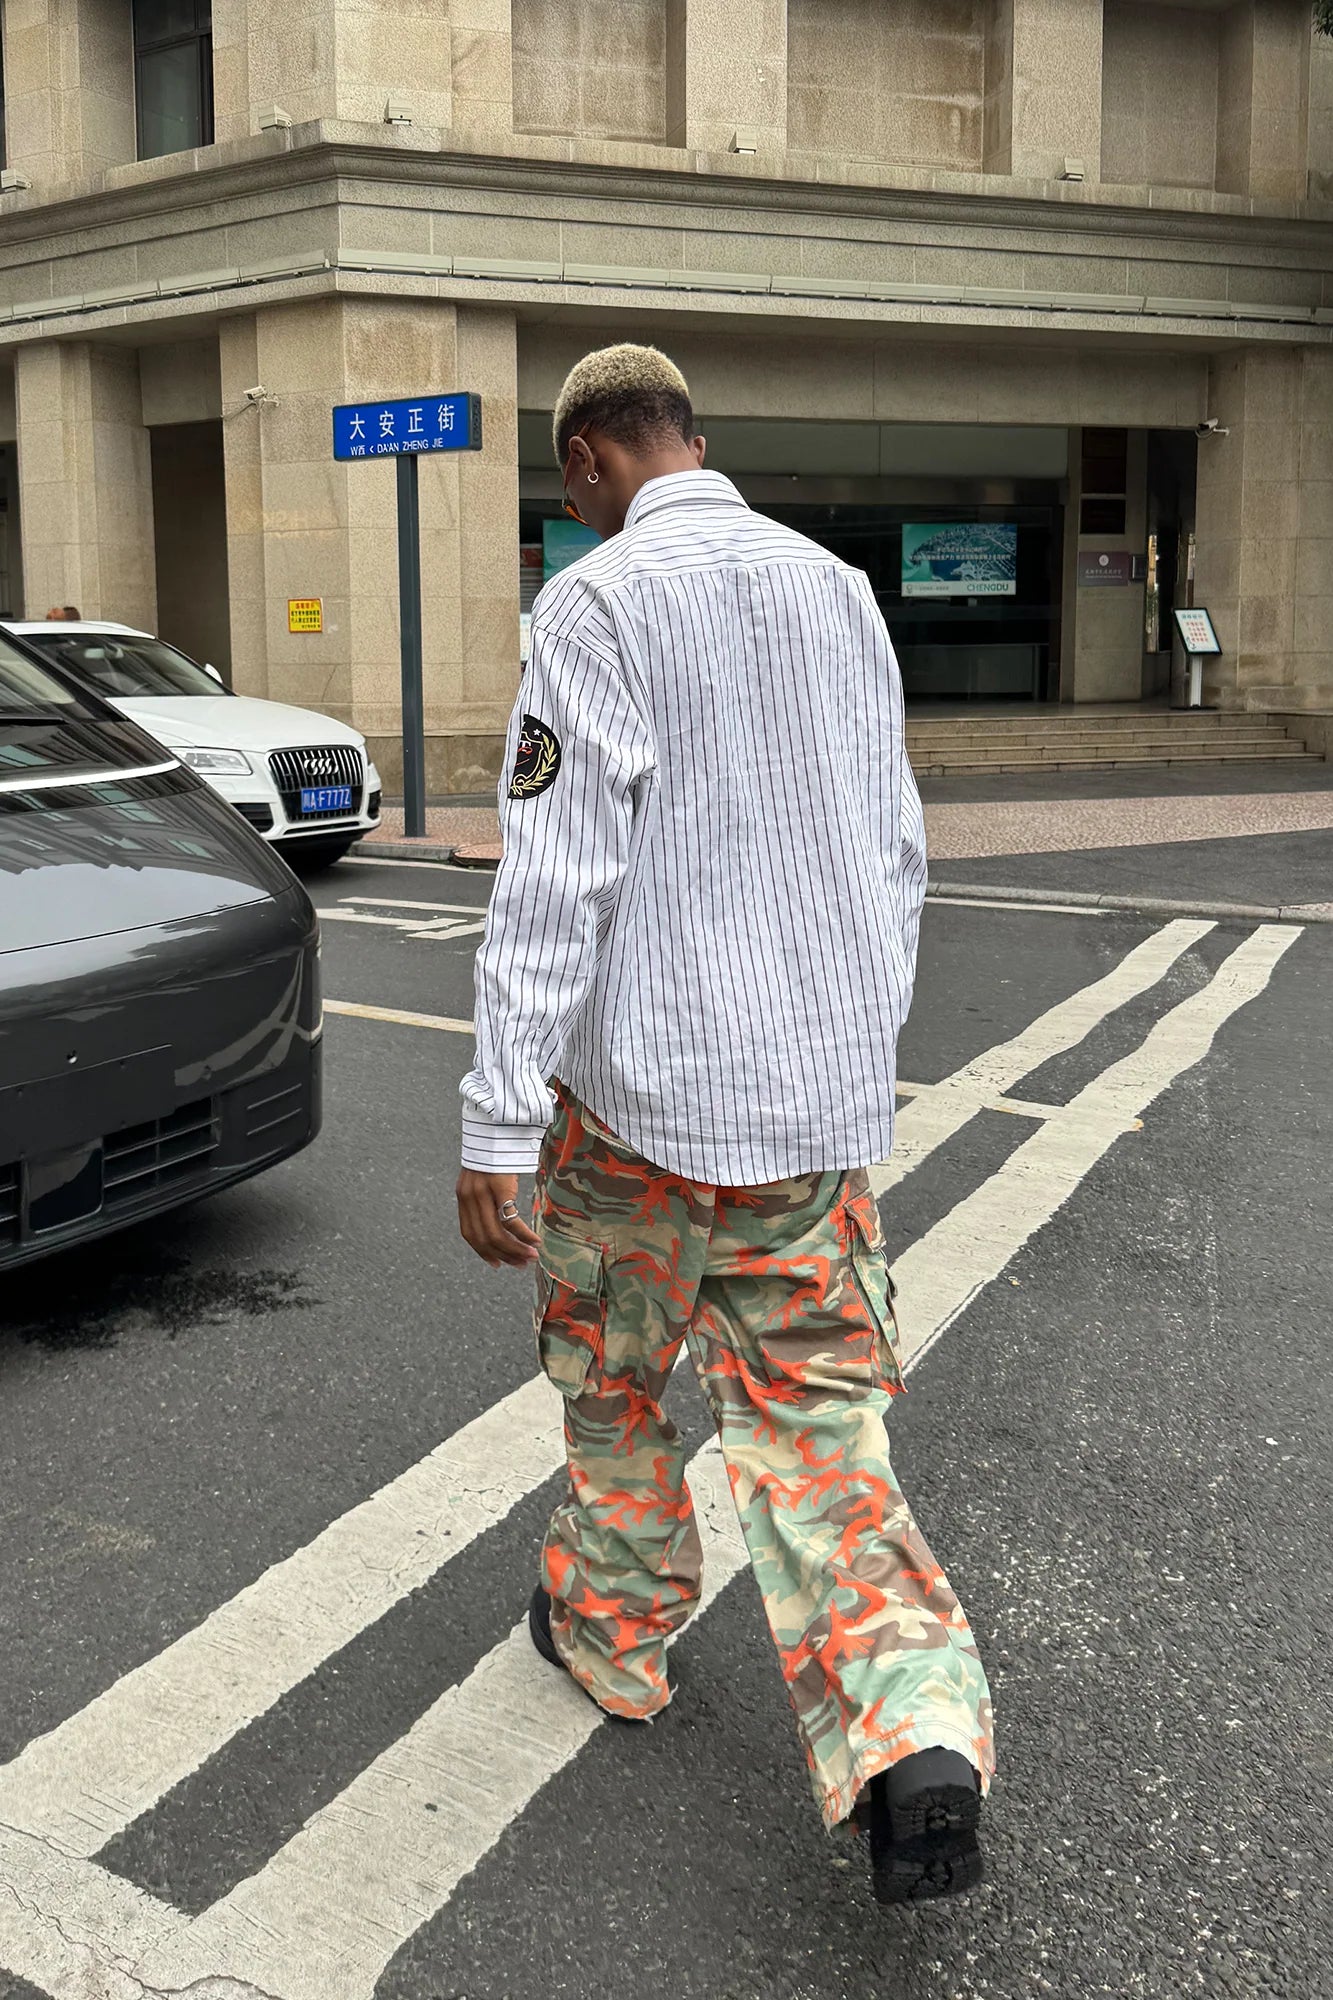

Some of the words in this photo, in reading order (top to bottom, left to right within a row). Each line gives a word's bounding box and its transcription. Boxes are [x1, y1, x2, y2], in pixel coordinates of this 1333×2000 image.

[349, 403, 455, 440] 大安正街
[402, 439, 429, 451] ZHENG
[432, 437, 444, 449] JIE
[966, 583, 1009, 592] CHENGDU
